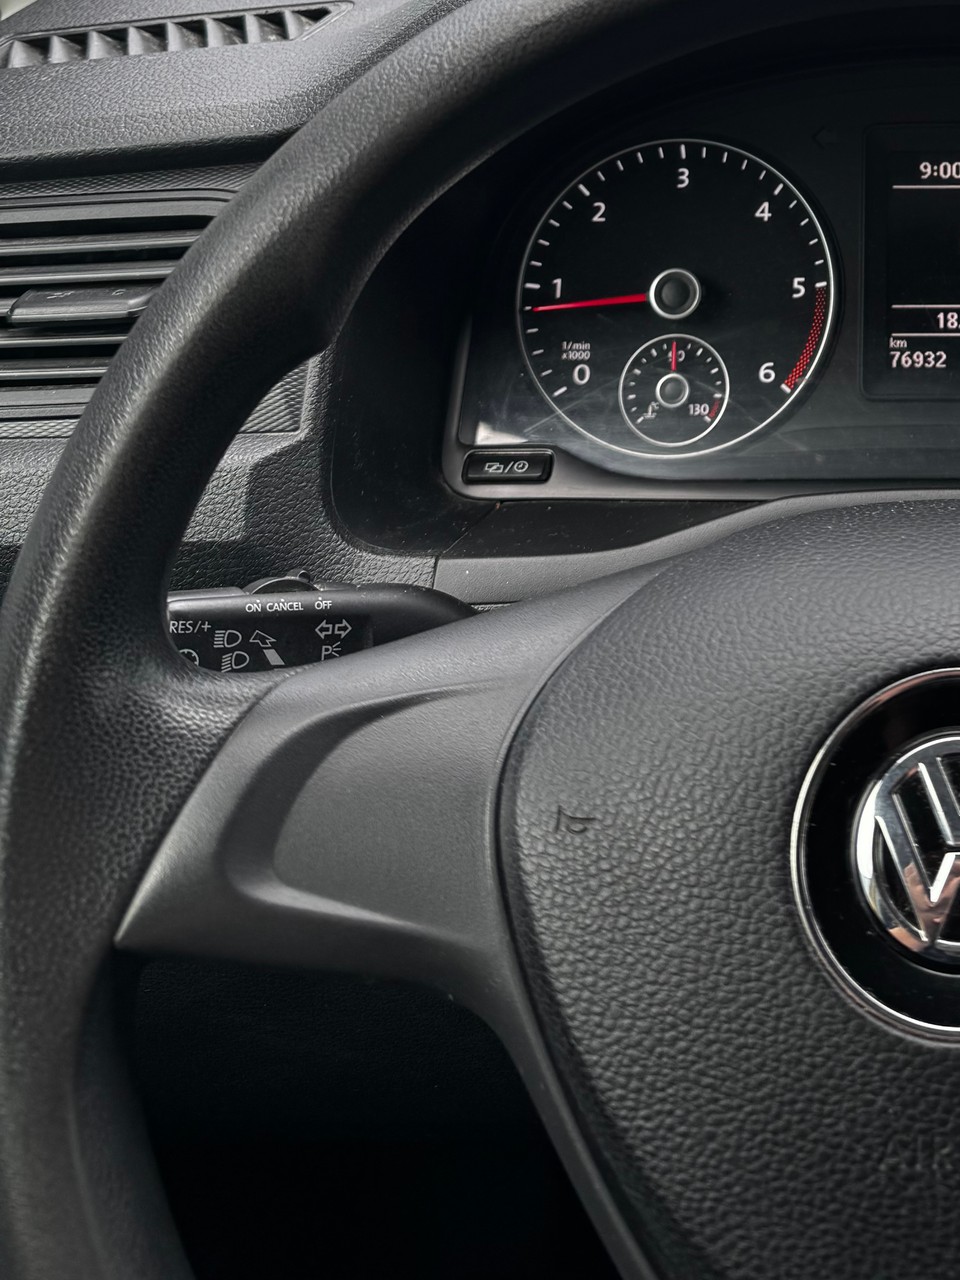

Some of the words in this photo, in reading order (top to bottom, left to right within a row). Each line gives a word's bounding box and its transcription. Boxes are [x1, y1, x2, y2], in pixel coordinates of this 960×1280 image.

[677, 168, 689, 188] 3
[592, 202, 605, 222] 2
[755, 202, 771, 221] 4
[553, 278, 561, 298] 1
[793, 278, 805, 298] 5
[562, 341, 591, 351] 1/min
[890, 337, 907, 348] km
[562, 350, 591, 360] x1000
[891, 351, 946, 368] 76932
[573, 364, 590, 385] 0
[759, 362, 775, 383] 6
[689, 404, 709, 417] 130
[245, 602, 262, 612] ON
[266, 601, 304, 612] CANCEL
[314, 600, 332, 609] OFF
